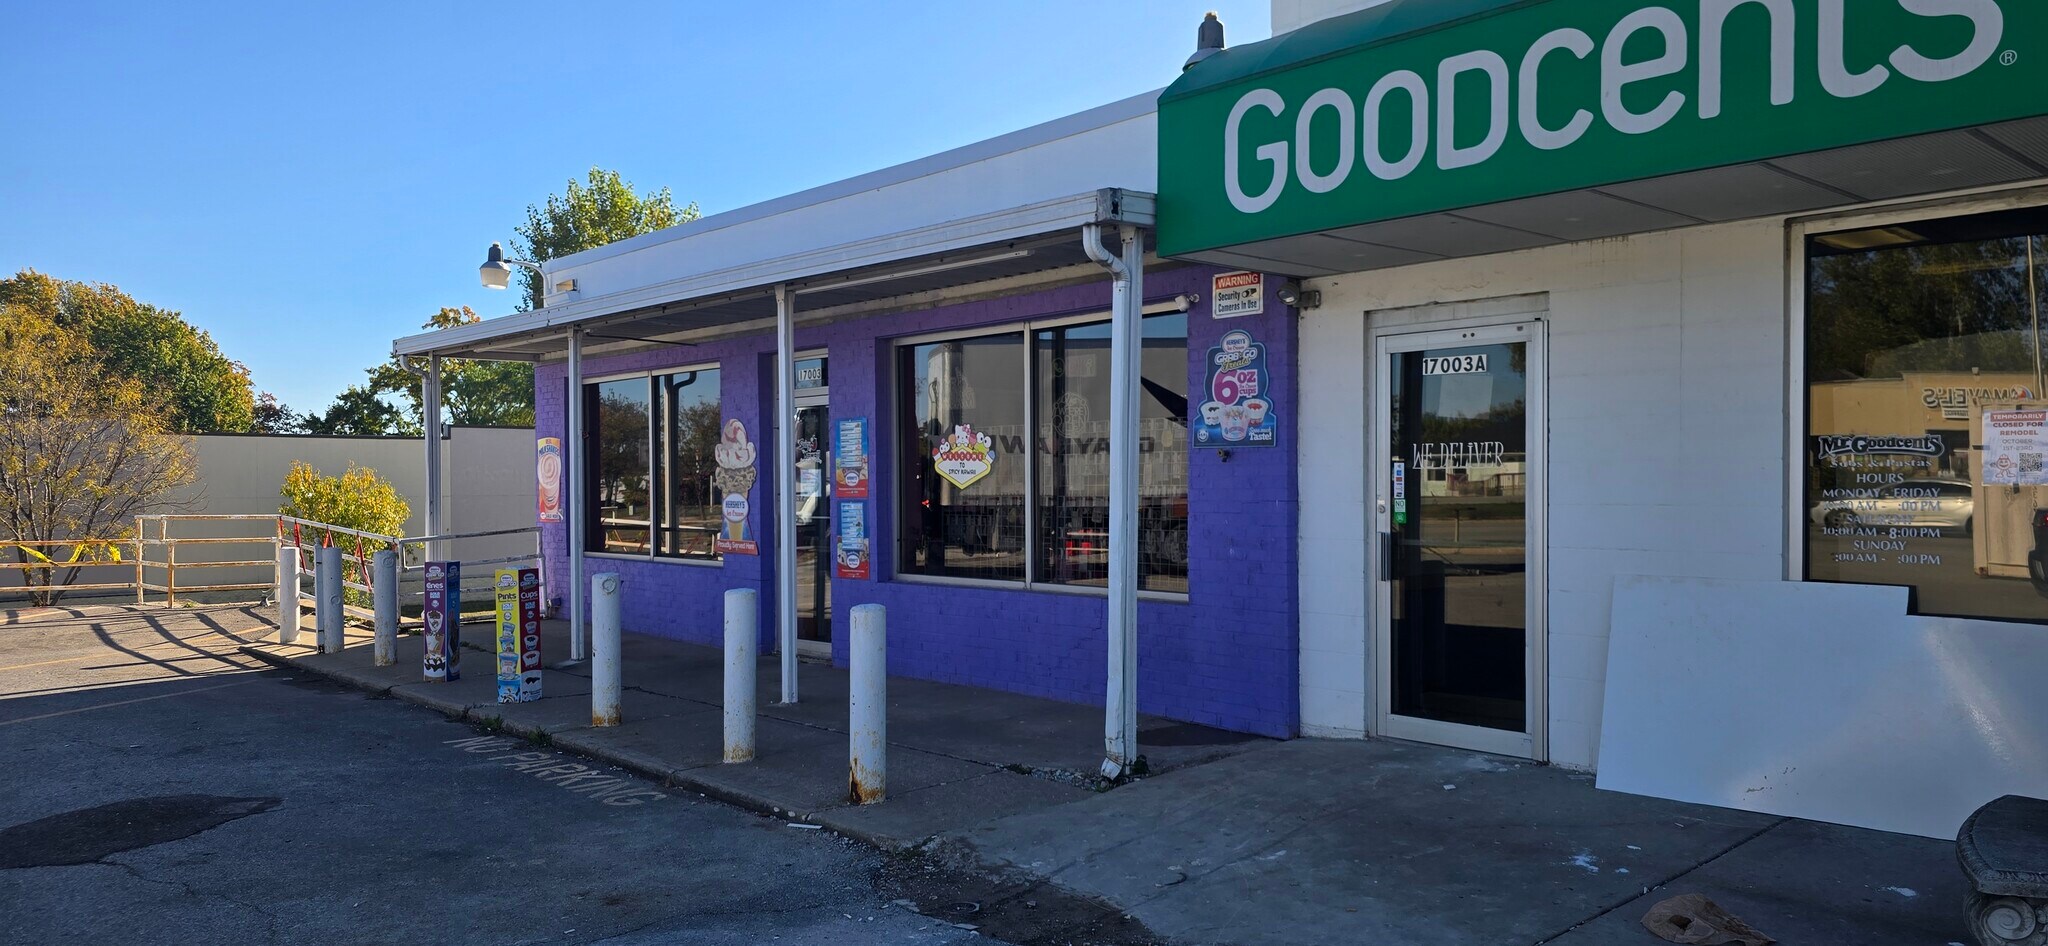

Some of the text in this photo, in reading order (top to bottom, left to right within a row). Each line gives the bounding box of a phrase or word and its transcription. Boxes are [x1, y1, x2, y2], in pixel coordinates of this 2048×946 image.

[1217, 273, 1259, 288] WARNING
[1217, 290, 1241, 301] Security
[1217, 300, 1257, 312] Cameras In Use
[1217, 349, 1256, 363] GRAB GO
[1222, 358, 1249, 370] Treats
[1423, 355, 1486, 375] 17003A
[799, 368, 821, 380] 17003
[1213, 369, 1239, 406] 6
[1240, 389, 1257, 397] cups
[1992, 413, 2044, 421] TEMPORARILY
[1249, 432, 1272, 440] Taste!
[942, 452, 984, 460] WELCOME
[1412, 443, 1435, 470] WE
[1856, 473, 1905, 484] HOURS
[1822, 488, 1881, 499] MONDAY
[1893, 487, 1941, 498] FRIDAY
[725, 500, 746, 509] HERSHEY'S
[1855, 500, 1879, 511] AM
[1920, 501, 1942, 512] PM
[1855, 526, 1878, 537] AM
[1888, 527, 1918, 540] 8:00
[1919, 527, 1941, 538] PM
[717, 541, 732, 550] Proudly
[732, 542, 746, 550] Served
[1853, 540, 1908, 551] SUNDAY
[1855, 553, 1878, 563] AM
[1919, 554, 1941, 565] PM
[497, 592, 517, 600] Pints
[520, 590, 538, 600] Cups
[487, 752, 668, 806] PARKING
